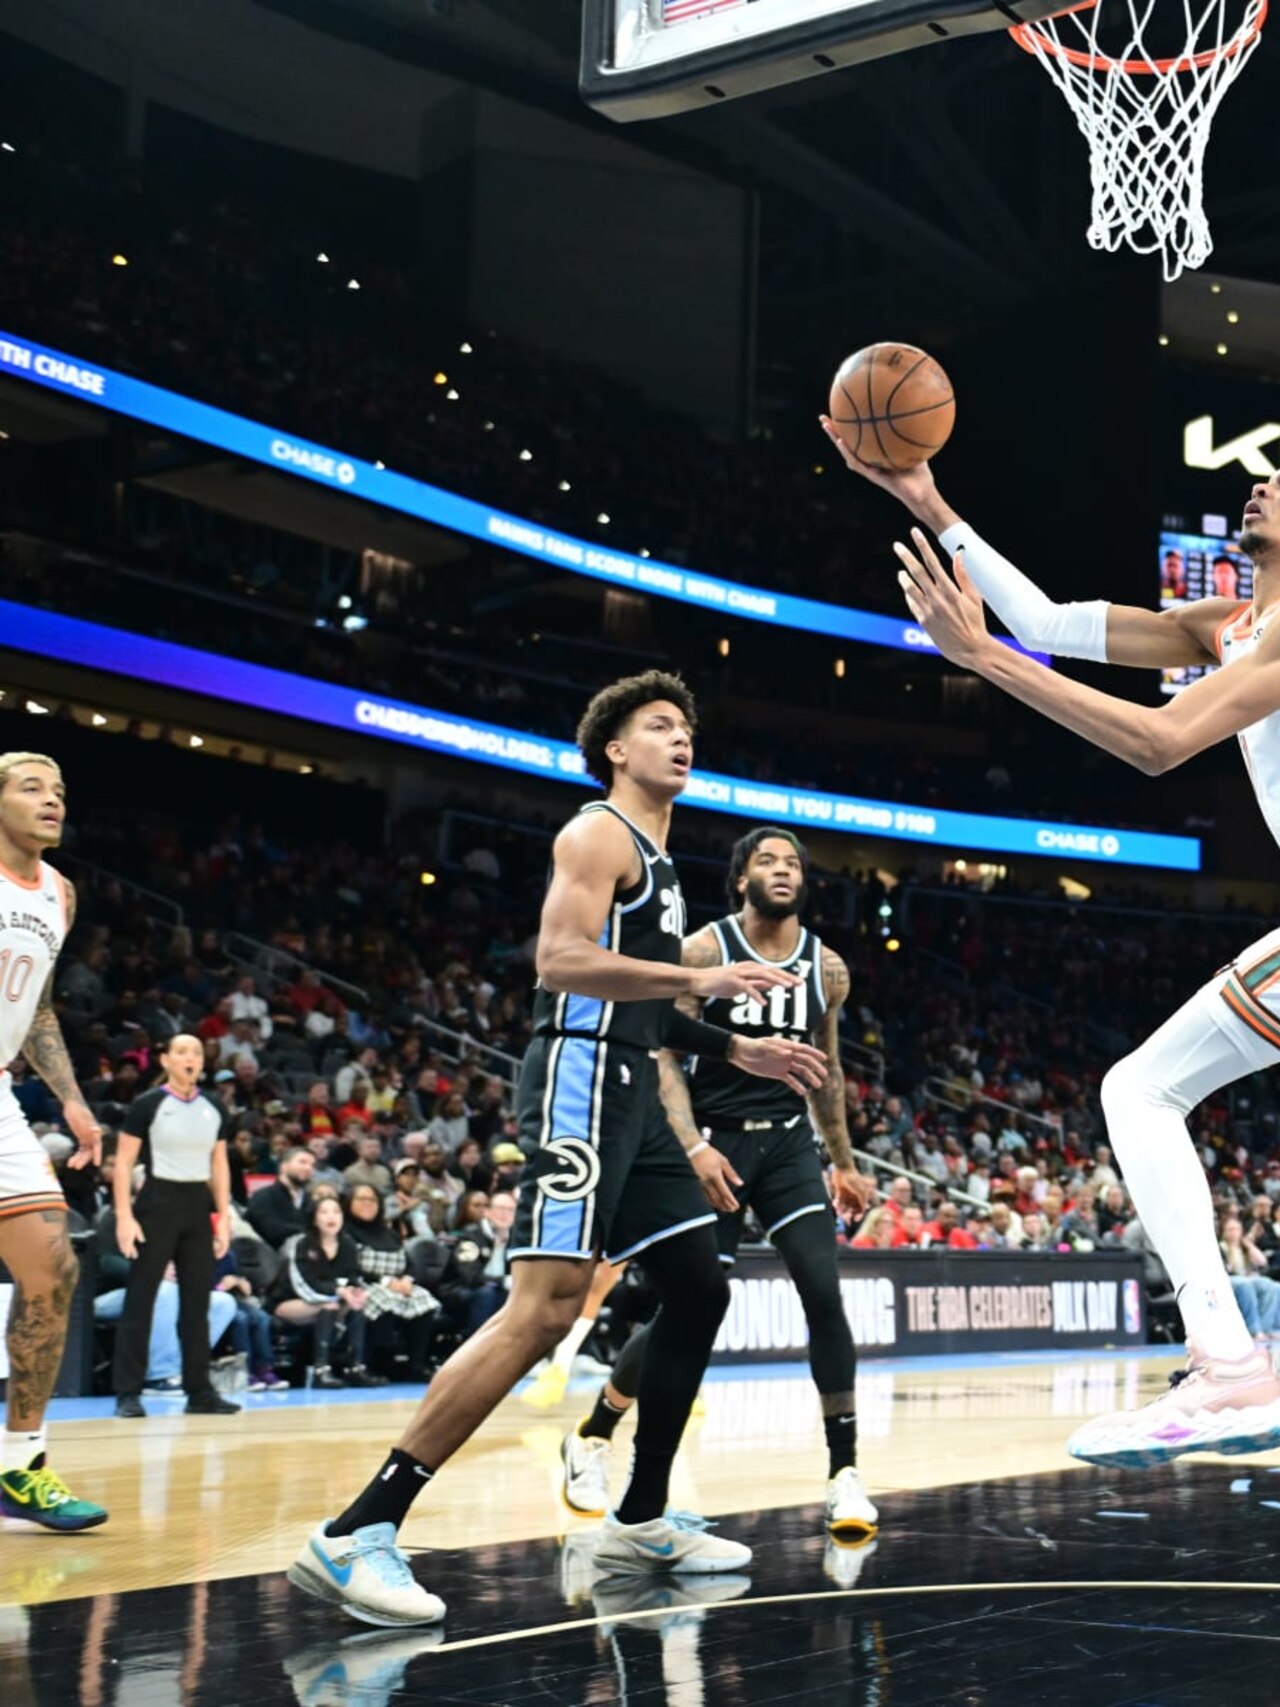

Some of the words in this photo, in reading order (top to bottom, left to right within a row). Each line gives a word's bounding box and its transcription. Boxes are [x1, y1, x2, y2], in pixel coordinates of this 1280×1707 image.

[34, 354, 106, 395] CHASE
[271, 440, 338, 478] CHASE
[792, 796, 832, 820] YOU
[1036, 829, 1100, 853] CHASE
[730, 960, 811, 1031] atl
[839, 1277, 896, 1345] ING
[905, 1286, 936, 1331] THE
[970, 1286, 1051, 1329] CELEBRATES
